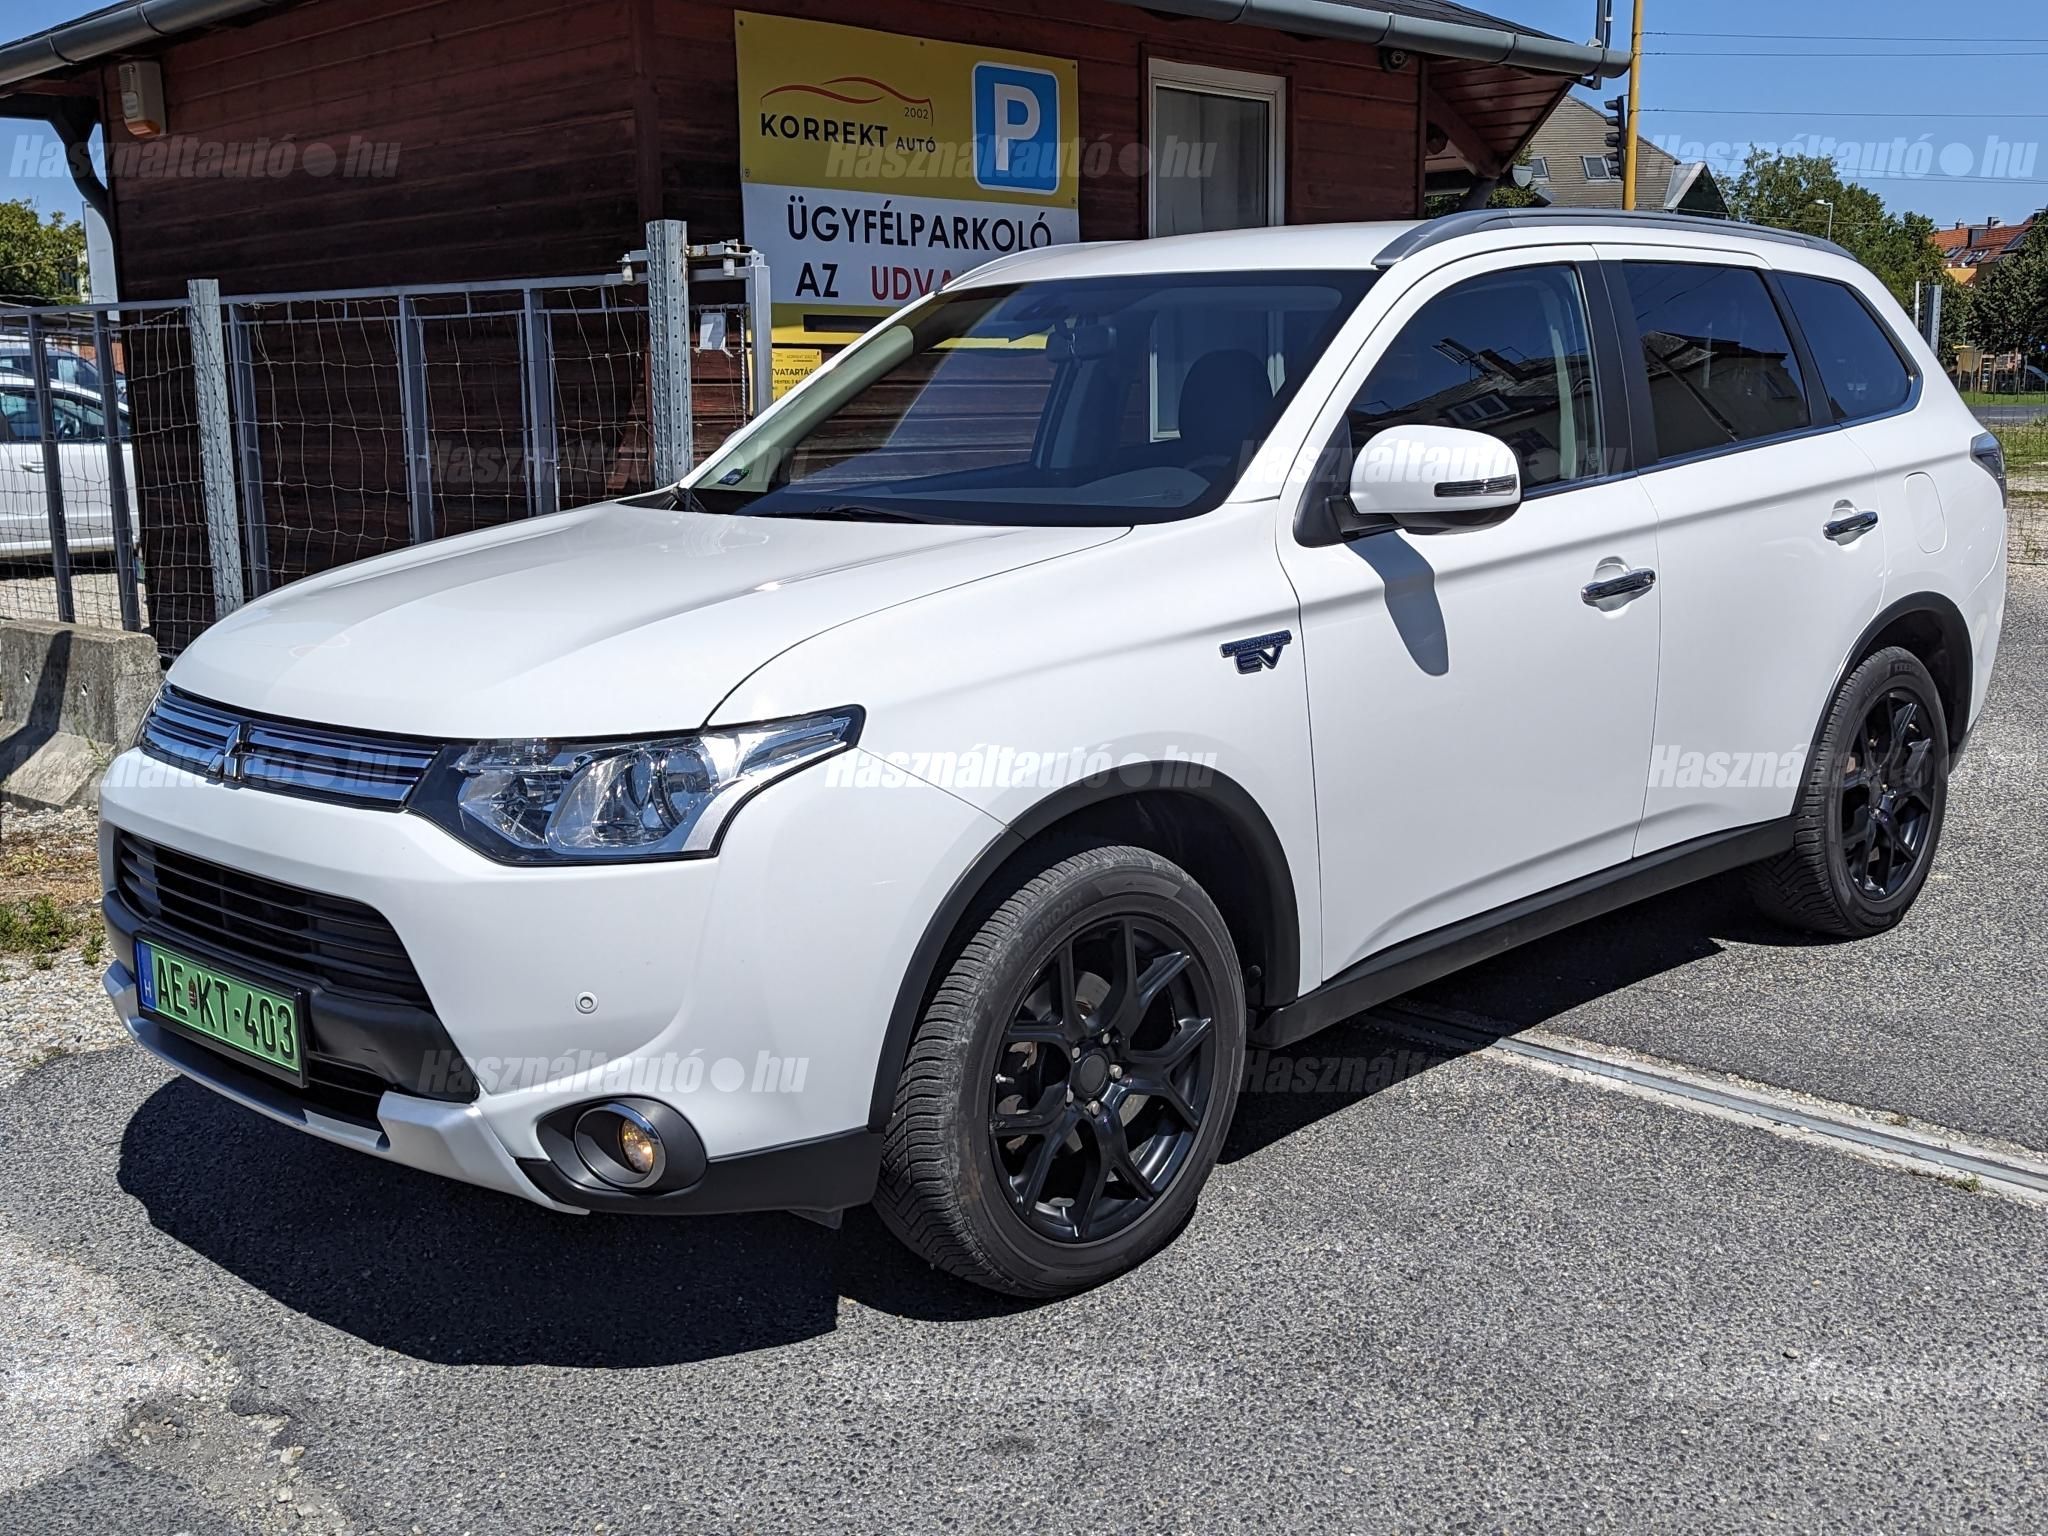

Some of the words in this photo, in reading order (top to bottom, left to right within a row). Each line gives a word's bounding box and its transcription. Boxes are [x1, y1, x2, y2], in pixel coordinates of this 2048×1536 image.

[760, 112, 889, 148] KORREKT
[896, 136, 936, 153] AUTÓ
[904, 106, 929, 120] 2002
[994, 83, 1041, 171] P
[787, 195, 1052, 252] ÜGYFÉLPARKOLÓ
[795, 262, 839, 298] AZ
[144, 979, 152, 999] H
[157, 955, 189, 1017] AE
[197, 972, 295, 1060] KT-403
